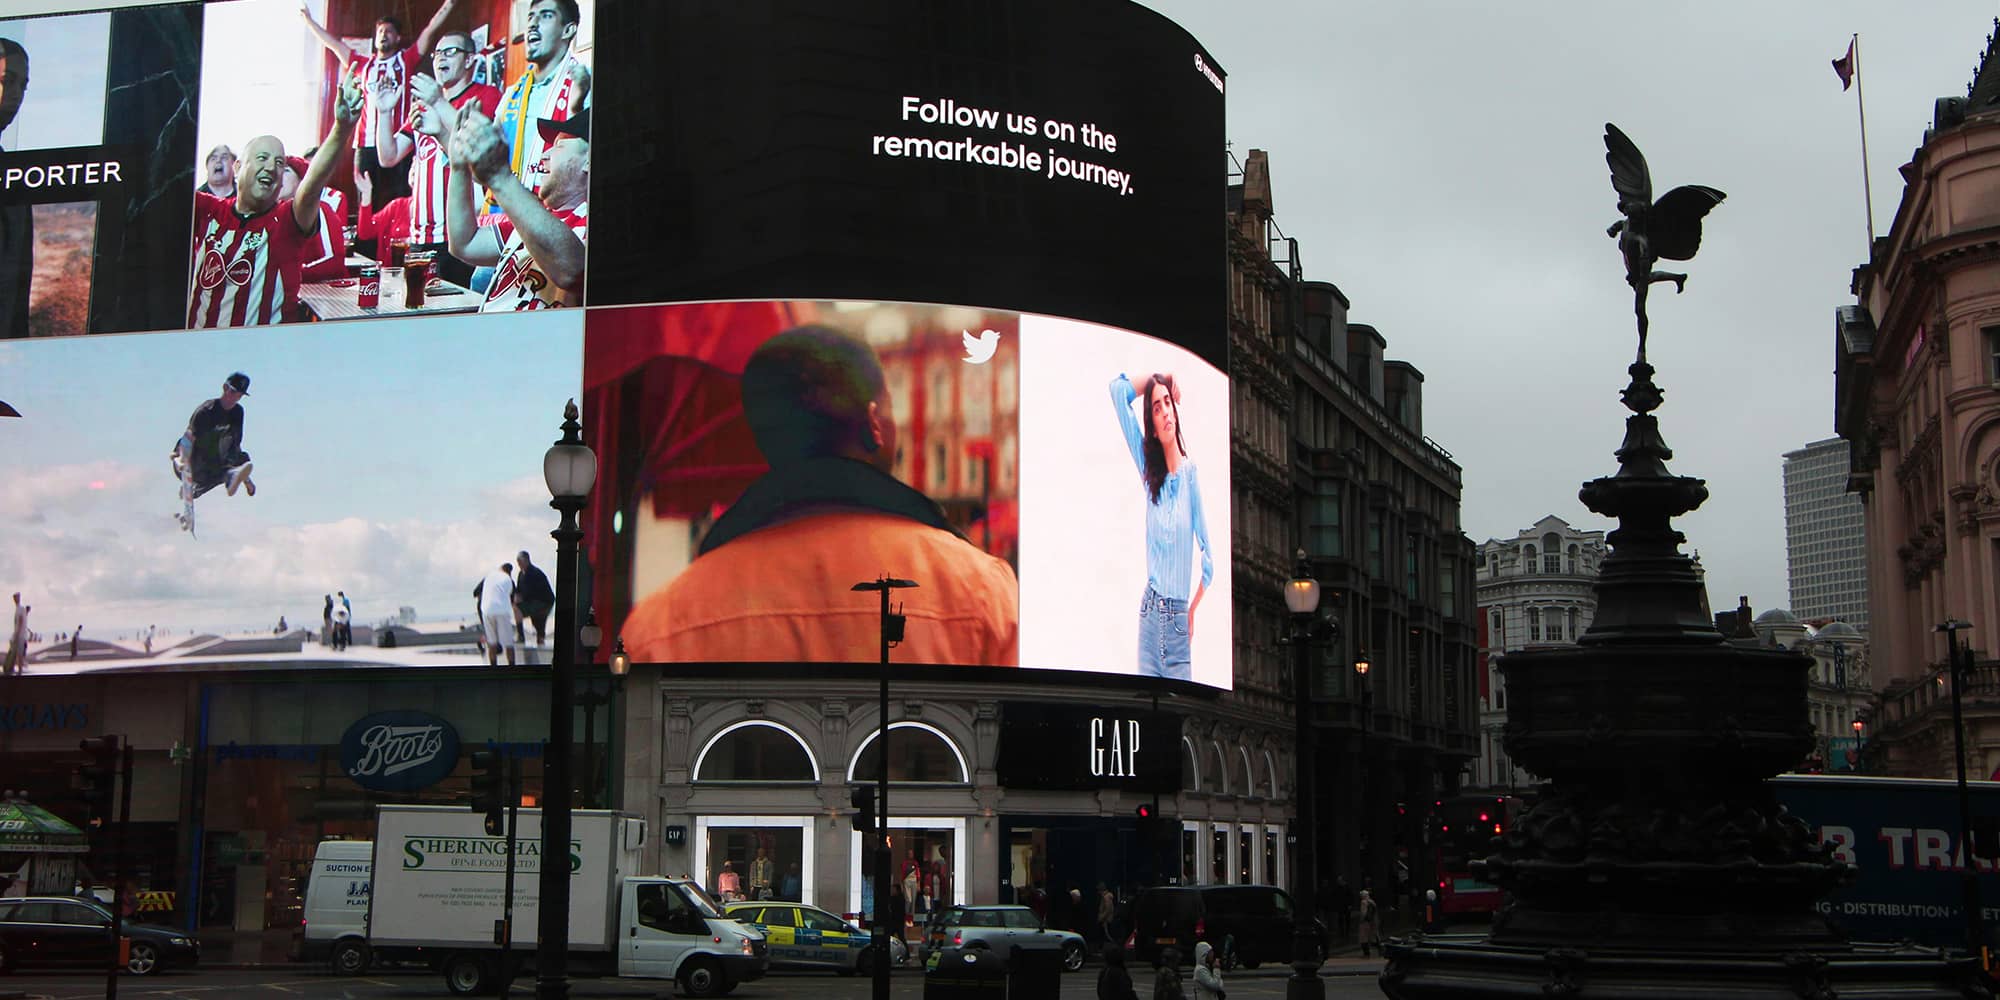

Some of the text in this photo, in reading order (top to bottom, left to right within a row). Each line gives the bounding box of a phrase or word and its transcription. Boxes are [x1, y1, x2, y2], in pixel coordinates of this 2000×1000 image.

[902, 96, 1117, 153] Follow us on the
[0, 161, 122, 189] PORTER
[872, 135, 1134, 196] remarkable journey.
[349, 724, 443, 776] Boots
[1090, 717, 1140, 777] GAP
[326, 864, 363, 873] SUCTION
[403, 838, 582, 872] SHERINGHAS
[479, 859, 507, 868] FOOD
[1844, 902, 1950, 919] DISTRIBUTION
[771, 947, 849, 962] POLICE
